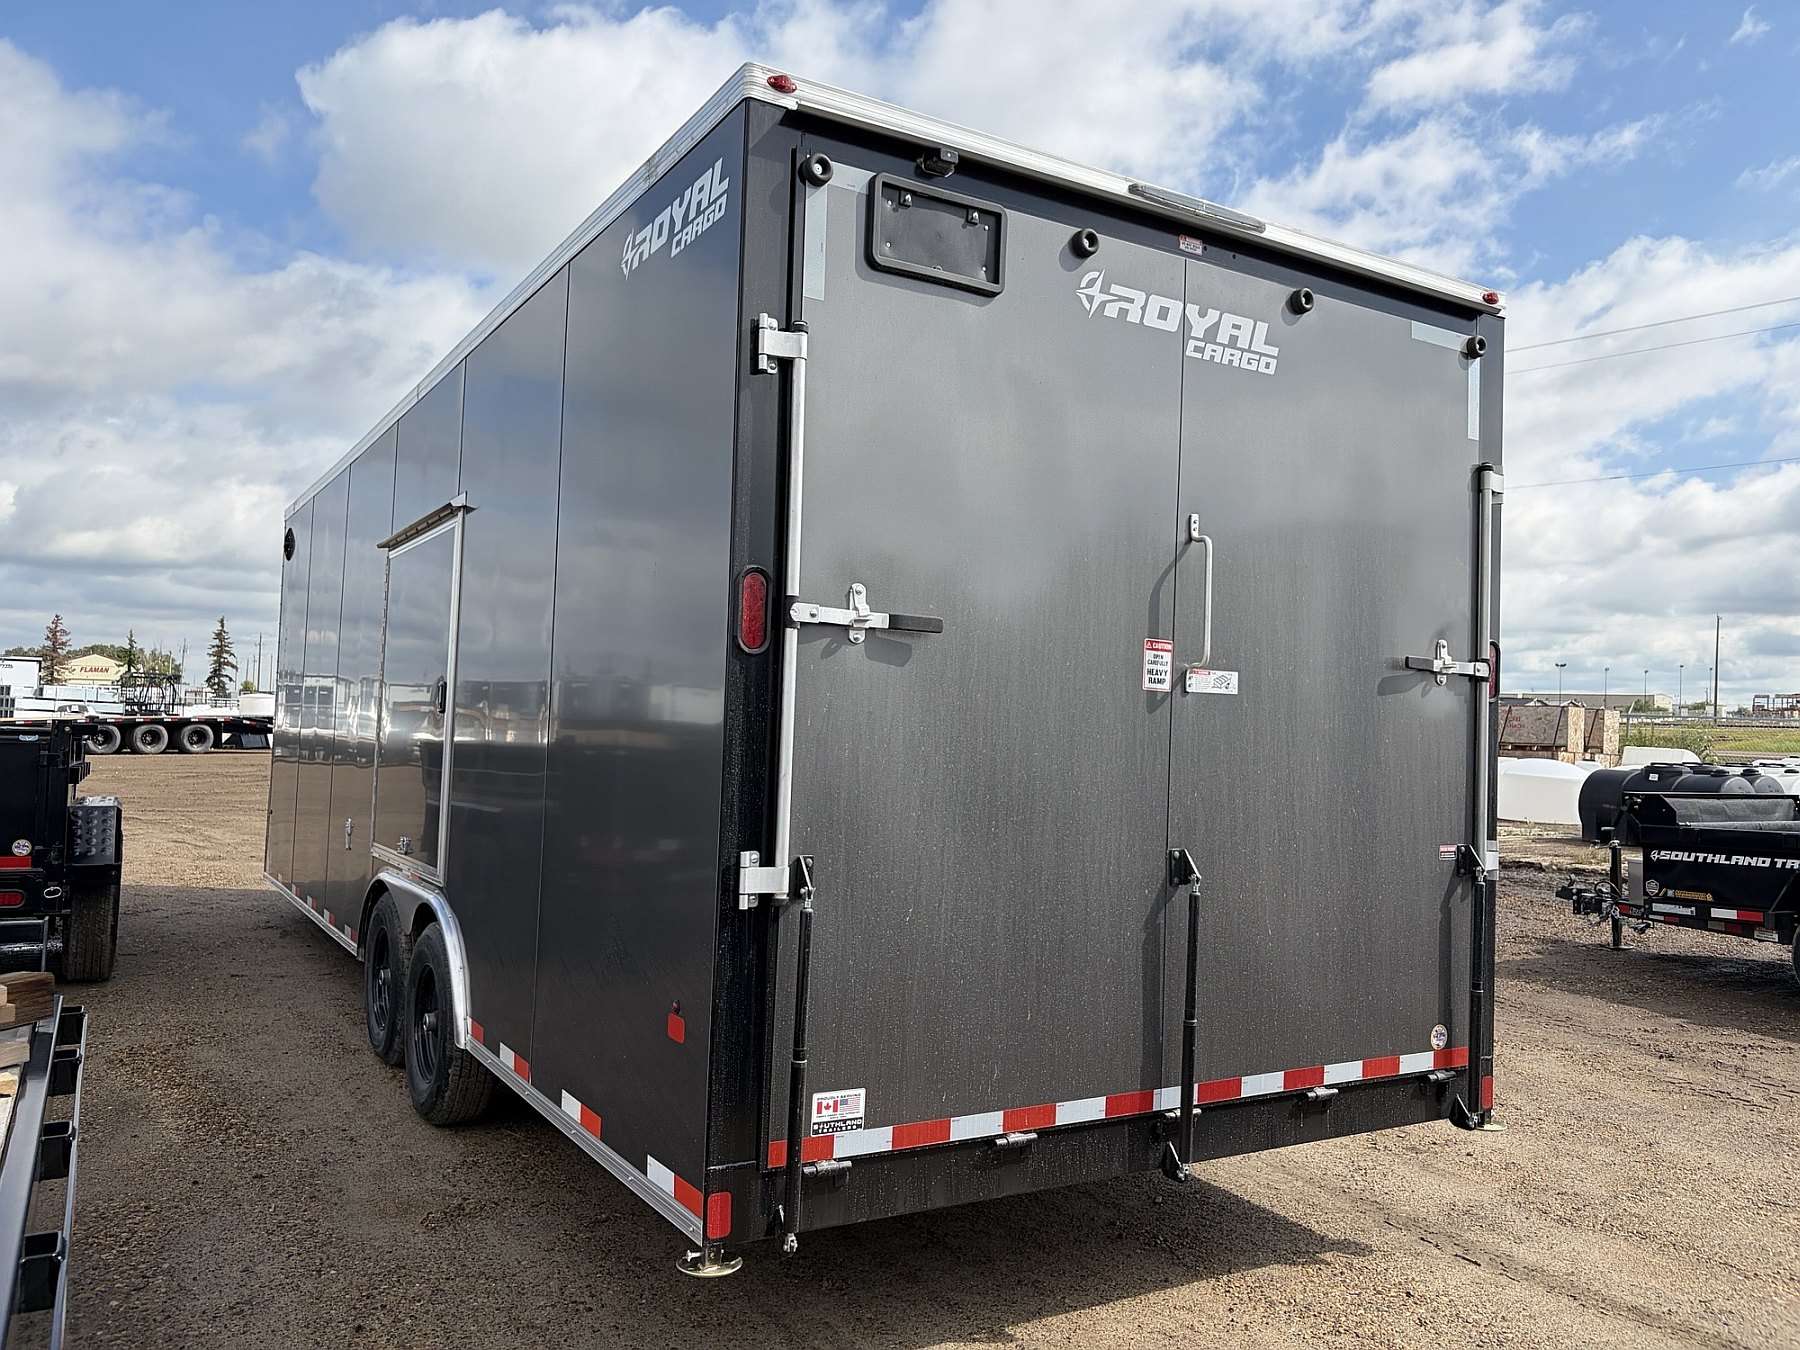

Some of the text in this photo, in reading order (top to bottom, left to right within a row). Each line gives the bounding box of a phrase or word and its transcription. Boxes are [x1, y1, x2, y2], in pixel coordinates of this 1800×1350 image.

[632, 157, 730, 271] ROYAL
[671, 193, 728, 258] CARGO
[1103, 283, 1280, 357] ROYAL
[1185, 339, 1278, 376] CARGO
[79, 666, 110, 674] FLAMAN
[1147, 668, 1168, 677] HEAVY
[1148, 677, 1167, 685] RAMP
[1659, 850, 1772, 868] SOUTHLAND
[813, 1119, 862, 1130] SOUTHLAND
